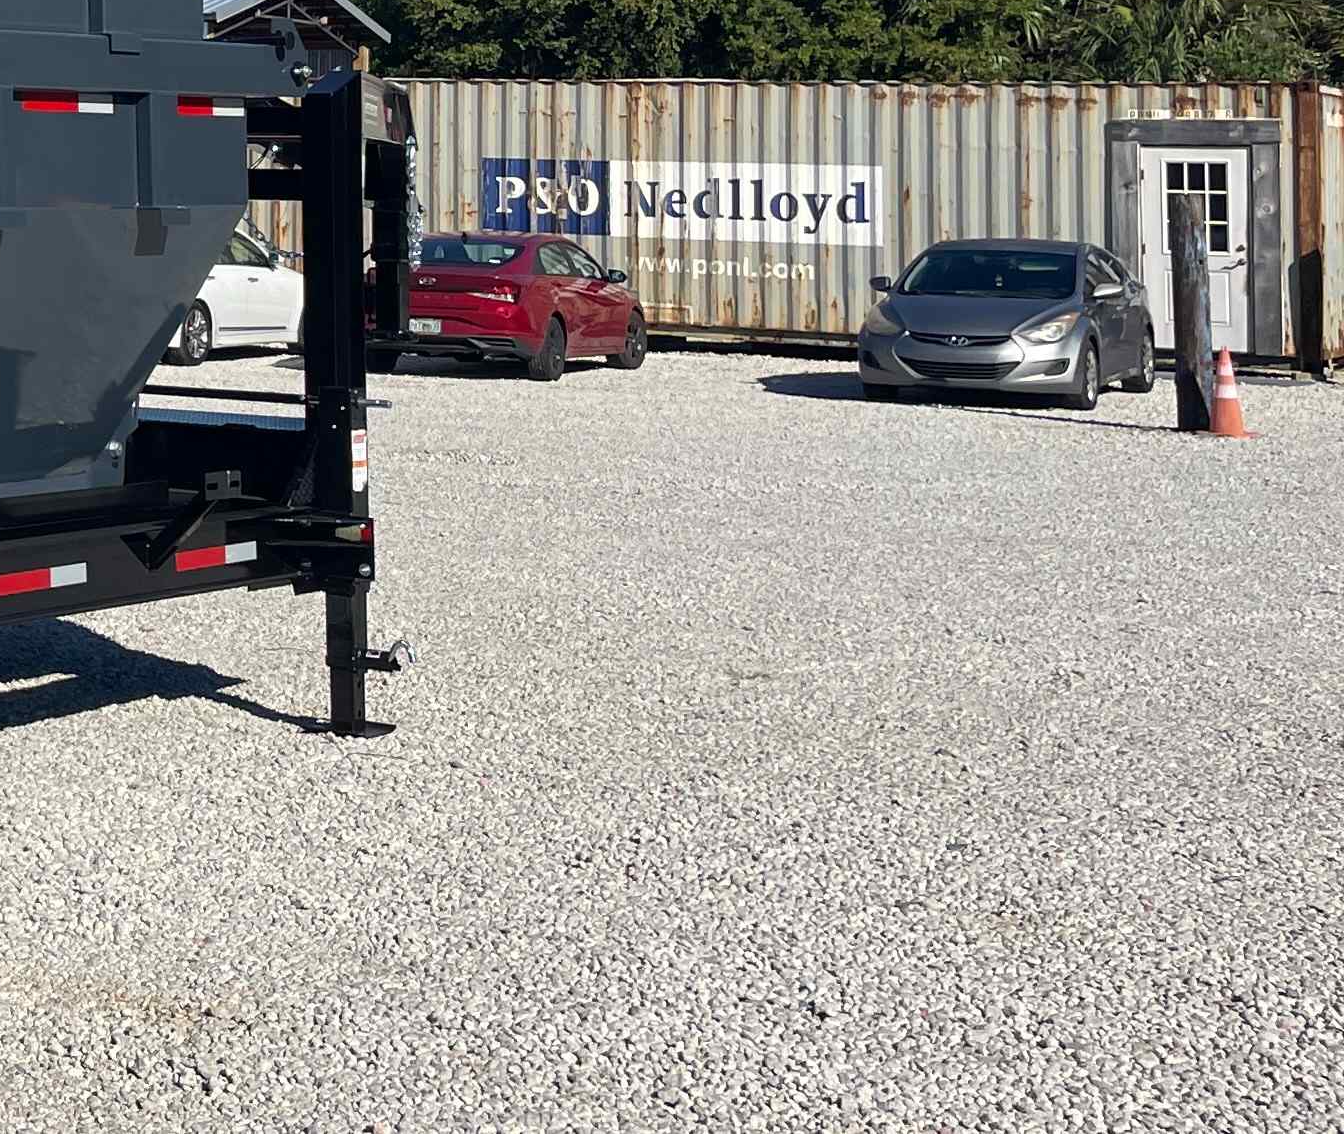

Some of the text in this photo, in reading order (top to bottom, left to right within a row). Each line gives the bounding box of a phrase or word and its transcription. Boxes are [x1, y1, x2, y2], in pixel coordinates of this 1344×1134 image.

[495, 175, 870, 235] P&O Nedlloyd
[625, 256, 815, 280] www.ponl.com
